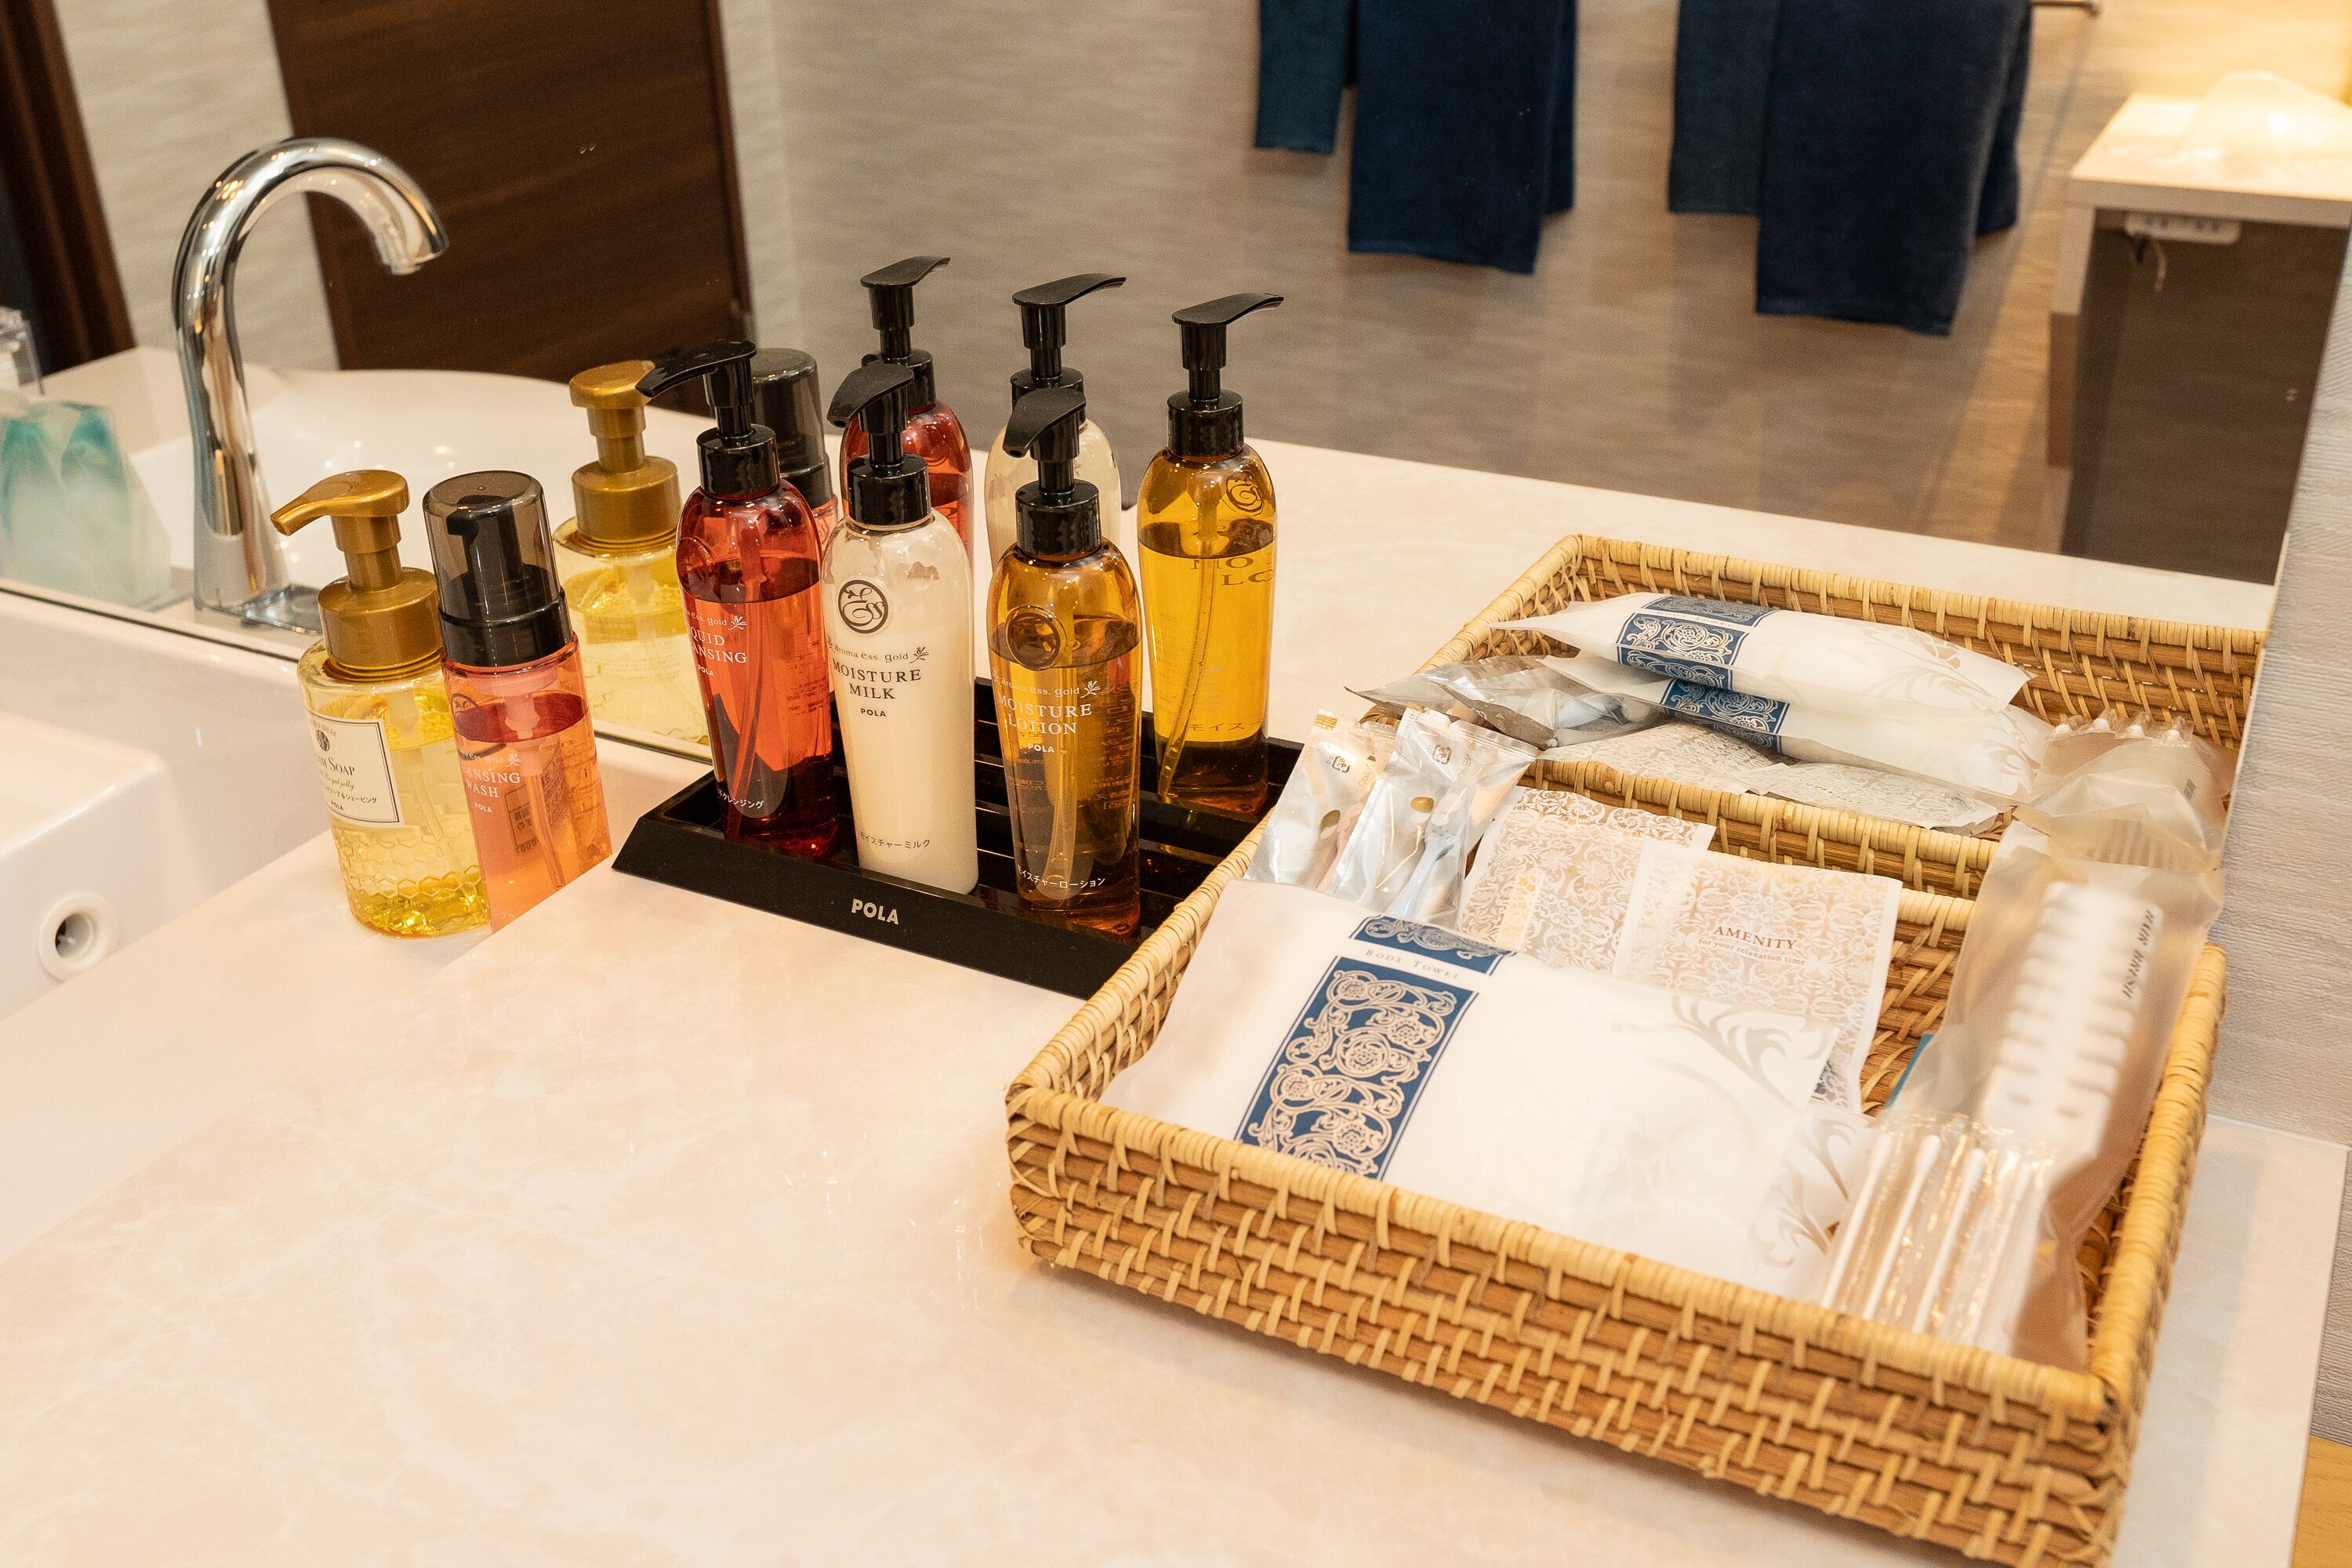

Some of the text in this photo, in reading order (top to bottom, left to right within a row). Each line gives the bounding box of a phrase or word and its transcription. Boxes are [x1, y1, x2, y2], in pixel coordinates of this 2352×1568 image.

[707, 617, 728, 626] gold
[690, 626, 725, 646] QUID
[692, 641, 748, 664] ANSING
[834, 643, 858, 659] aroma
[884, 652, 909, 663] gold
[832, 658, 922, 684] MOISTURE
[848, 683, 896, 700] MILK
[1001, 677, 1027, 693] aroma
[1054, 688, 1080, 698] gold
[860, 707, 887, 718] POLA
[997, 690, 1093, 718] MOISTURE
[1007, 713, 1078, 735] LOTION
[1027, 742, 1055, 753] POLA
[464, 766, 521, 784] ANSING
[466, 779, 499, 798] WASH
[474, 802, 493, 814] POLA
[860, 829, 931, 849] モイスチャーミルク
[851, 898, 900, 925] POLA
[1713, 926, 1798, 950] AMENITY
[1364, 948, 1404, 964] BODY
[1698, 938, 1807, 966] for your relaxation time
